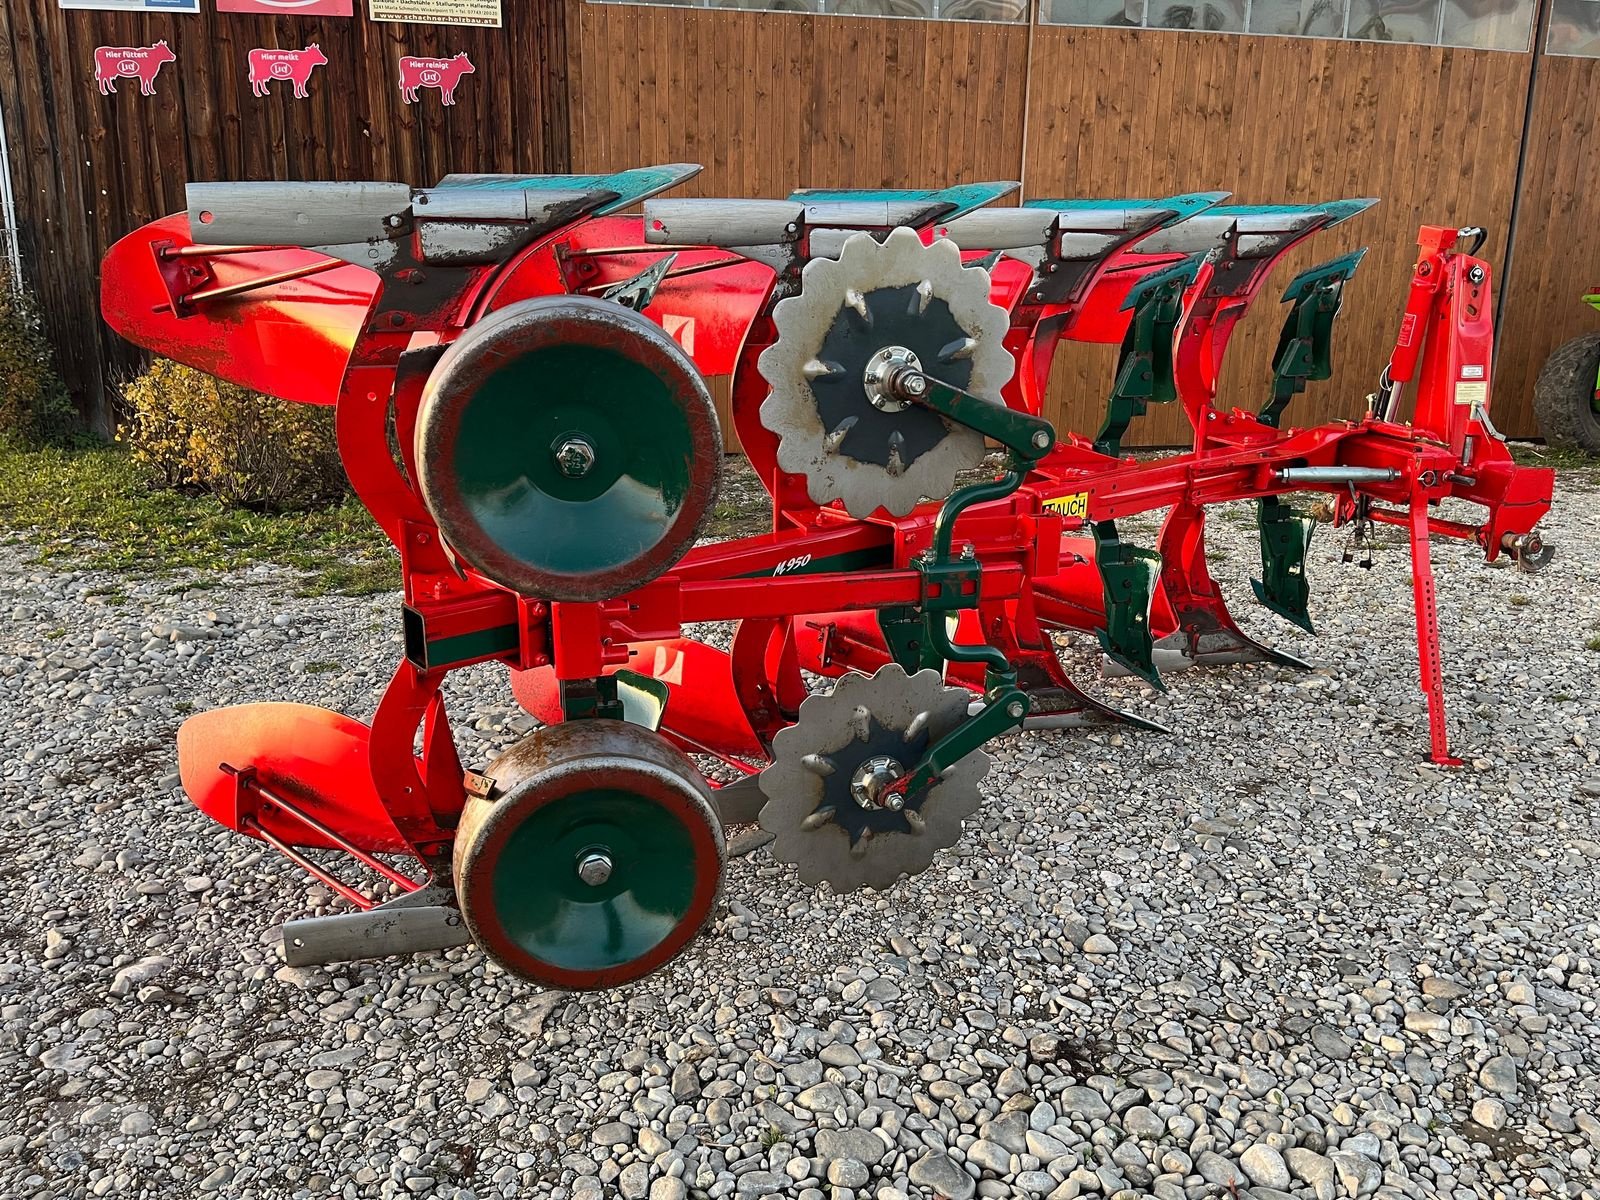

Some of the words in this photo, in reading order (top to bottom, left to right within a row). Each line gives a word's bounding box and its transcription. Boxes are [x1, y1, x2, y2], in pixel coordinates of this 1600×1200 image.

[436, 1, 466, 9] Stallungen
[379, 12, 493, 24] www.schachner-holzbau.at
[122, 50, 149, 59] füttert
[277, 53, 299, 61] melkt
[425, 62, 449, 70] reinigt
